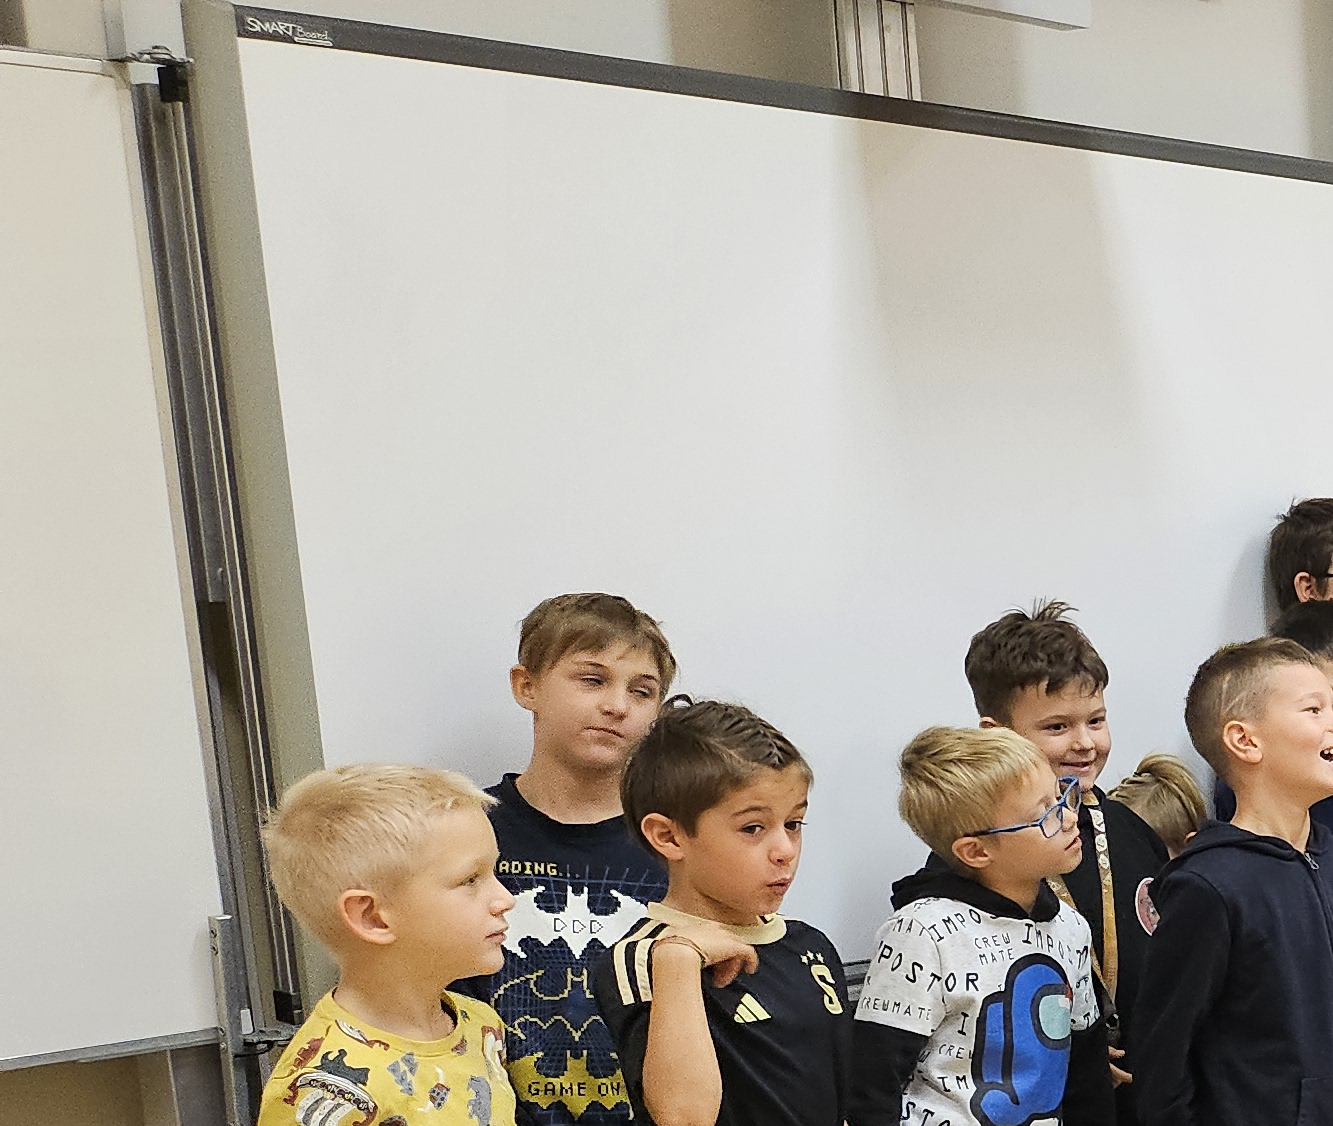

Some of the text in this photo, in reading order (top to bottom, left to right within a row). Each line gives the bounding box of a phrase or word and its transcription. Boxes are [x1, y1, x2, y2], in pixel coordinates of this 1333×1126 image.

[245, 17, 329, 40] SMART Board
[499, 860, 581, 877] ADING...
[928, 908, 982, 943] IMPO
[974, 931, 1012, 949] CREW
[979, 948, 1016, 966] MATE
[878, 940, 979, 993] POSTOR
[527, 1081, 621, 1097] GAME ON
[937, 1074, 969, 1092] IM
